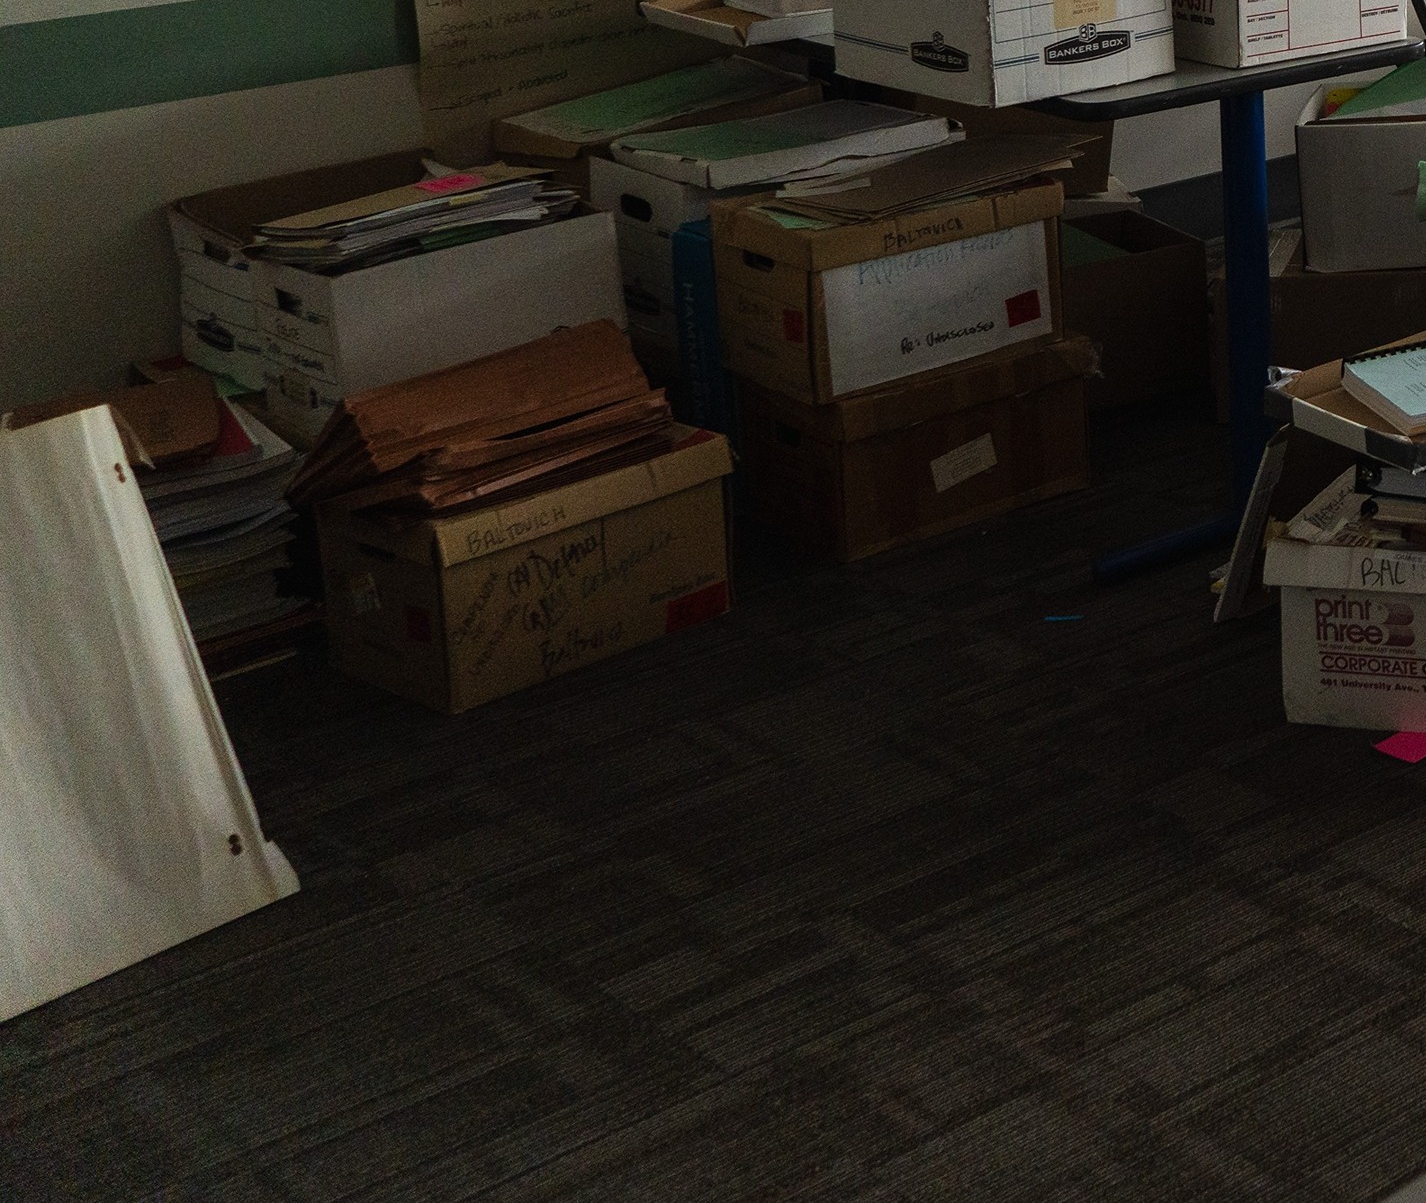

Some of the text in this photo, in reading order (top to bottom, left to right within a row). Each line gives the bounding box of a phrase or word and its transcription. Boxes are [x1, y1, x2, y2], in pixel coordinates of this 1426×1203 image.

[914, 49, 964, 67] BANKERS BOX
[1048, 37, 1124, 59] BANKERS BOX
[884, 217, 964, 251] BALTOVICH
[466, 506, 566, 555] BALTOVICH
[1315, 595, 1372, 621] print
[1316, 614, 1384, 644] three
[1320, 655, 1418, 676] CORPORATE
[1341, 679, 1392, 691] University
